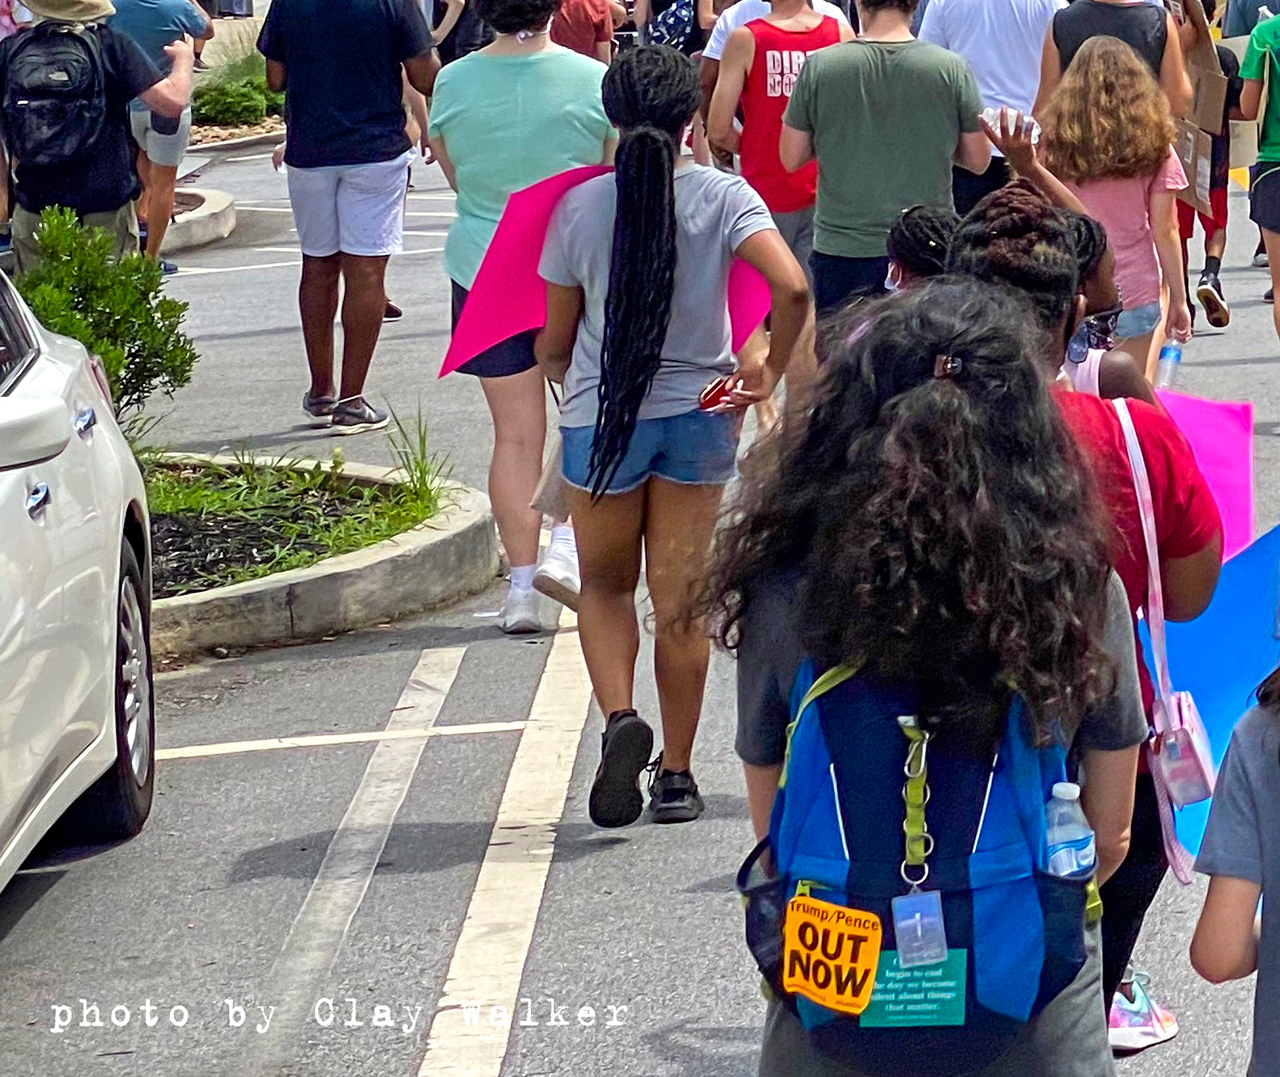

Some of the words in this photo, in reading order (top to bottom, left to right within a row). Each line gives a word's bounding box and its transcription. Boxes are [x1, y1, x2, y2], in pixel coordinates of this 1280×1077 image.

[765, 50, 819, 74] DIR
[790, 898, 880, 932] Trump/Pence
[798, 920, 869, 965] OUT
[788, 948, 872, 999] NOW
[922, 980, 958, 989] become
